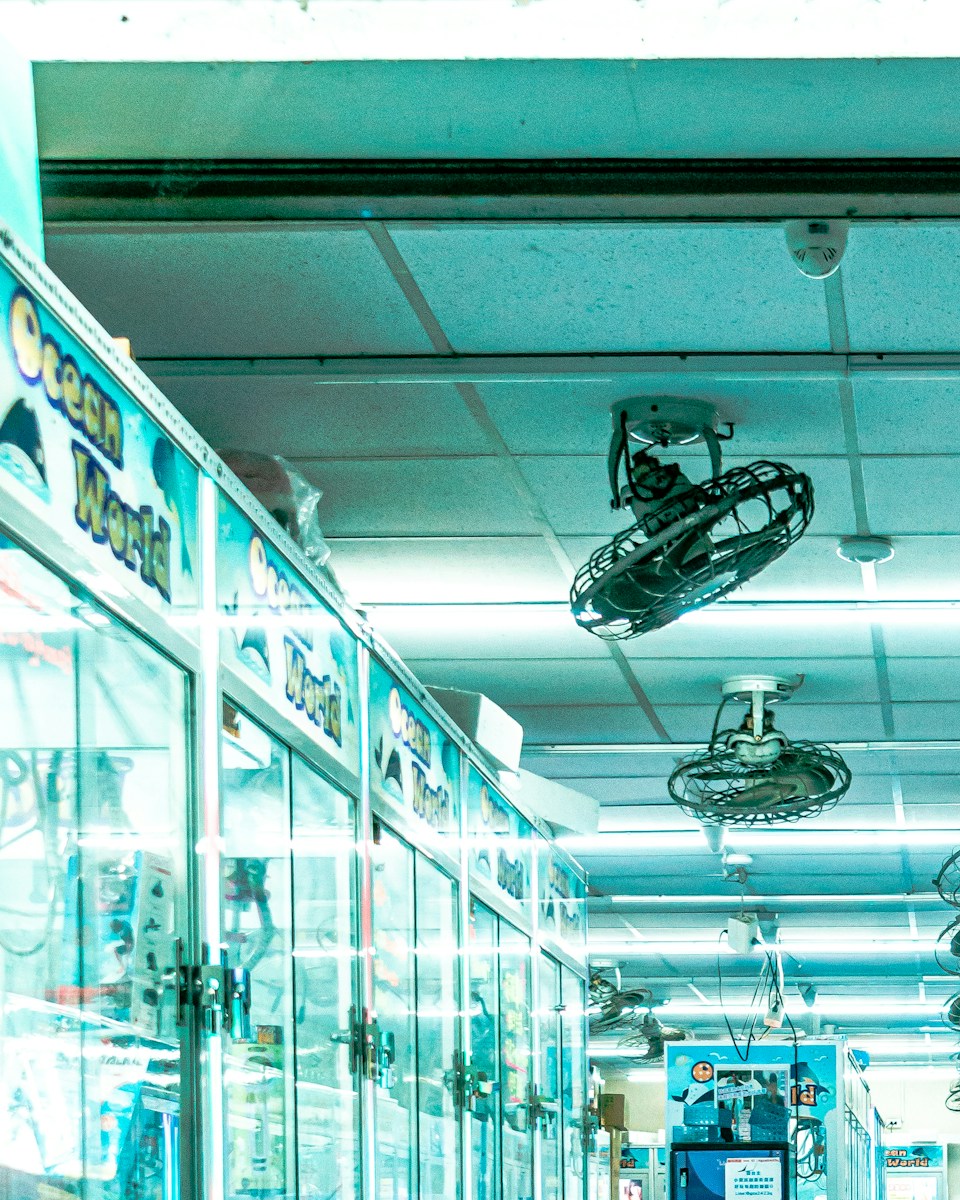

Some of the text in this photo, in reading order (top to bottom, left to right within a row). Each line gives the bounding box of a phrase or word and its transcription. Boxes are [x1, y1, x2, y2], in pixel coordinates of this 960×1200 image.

[9, 284, 124, 471] Ocean
[71, 438, 172, 605] World
[284, 633, 343, 748] World
[389, 682, 432, 770] Ocean
[886, 1157, 930, 1168] World
